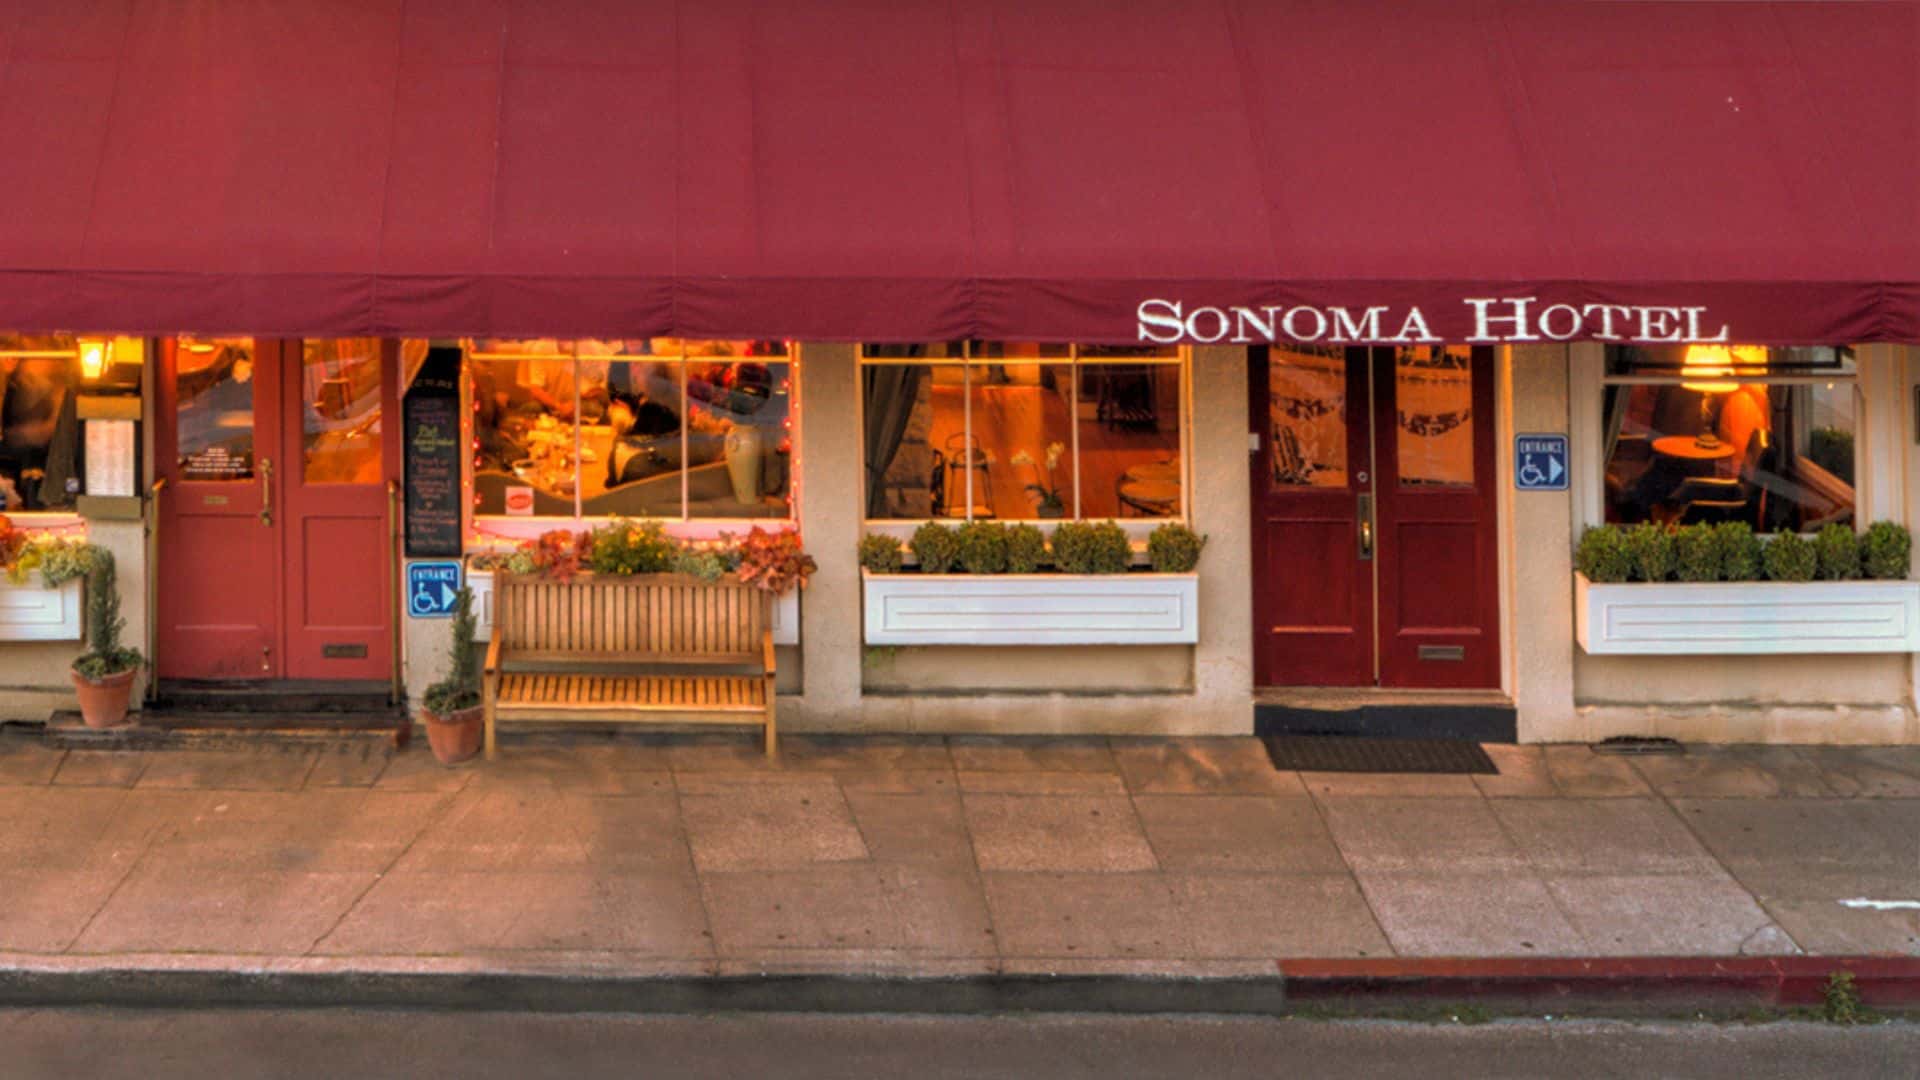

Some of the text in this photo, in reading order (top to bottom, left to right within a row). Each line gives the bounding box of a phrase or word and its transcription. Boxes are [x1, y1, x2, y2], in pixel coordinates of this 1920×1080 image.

[1137, 297, 1728, 342] SONOMA HOTEL
[1519, 441, 1562, 453] ENTRANCE
[413, 568, 455, 581] ENTRANCE
